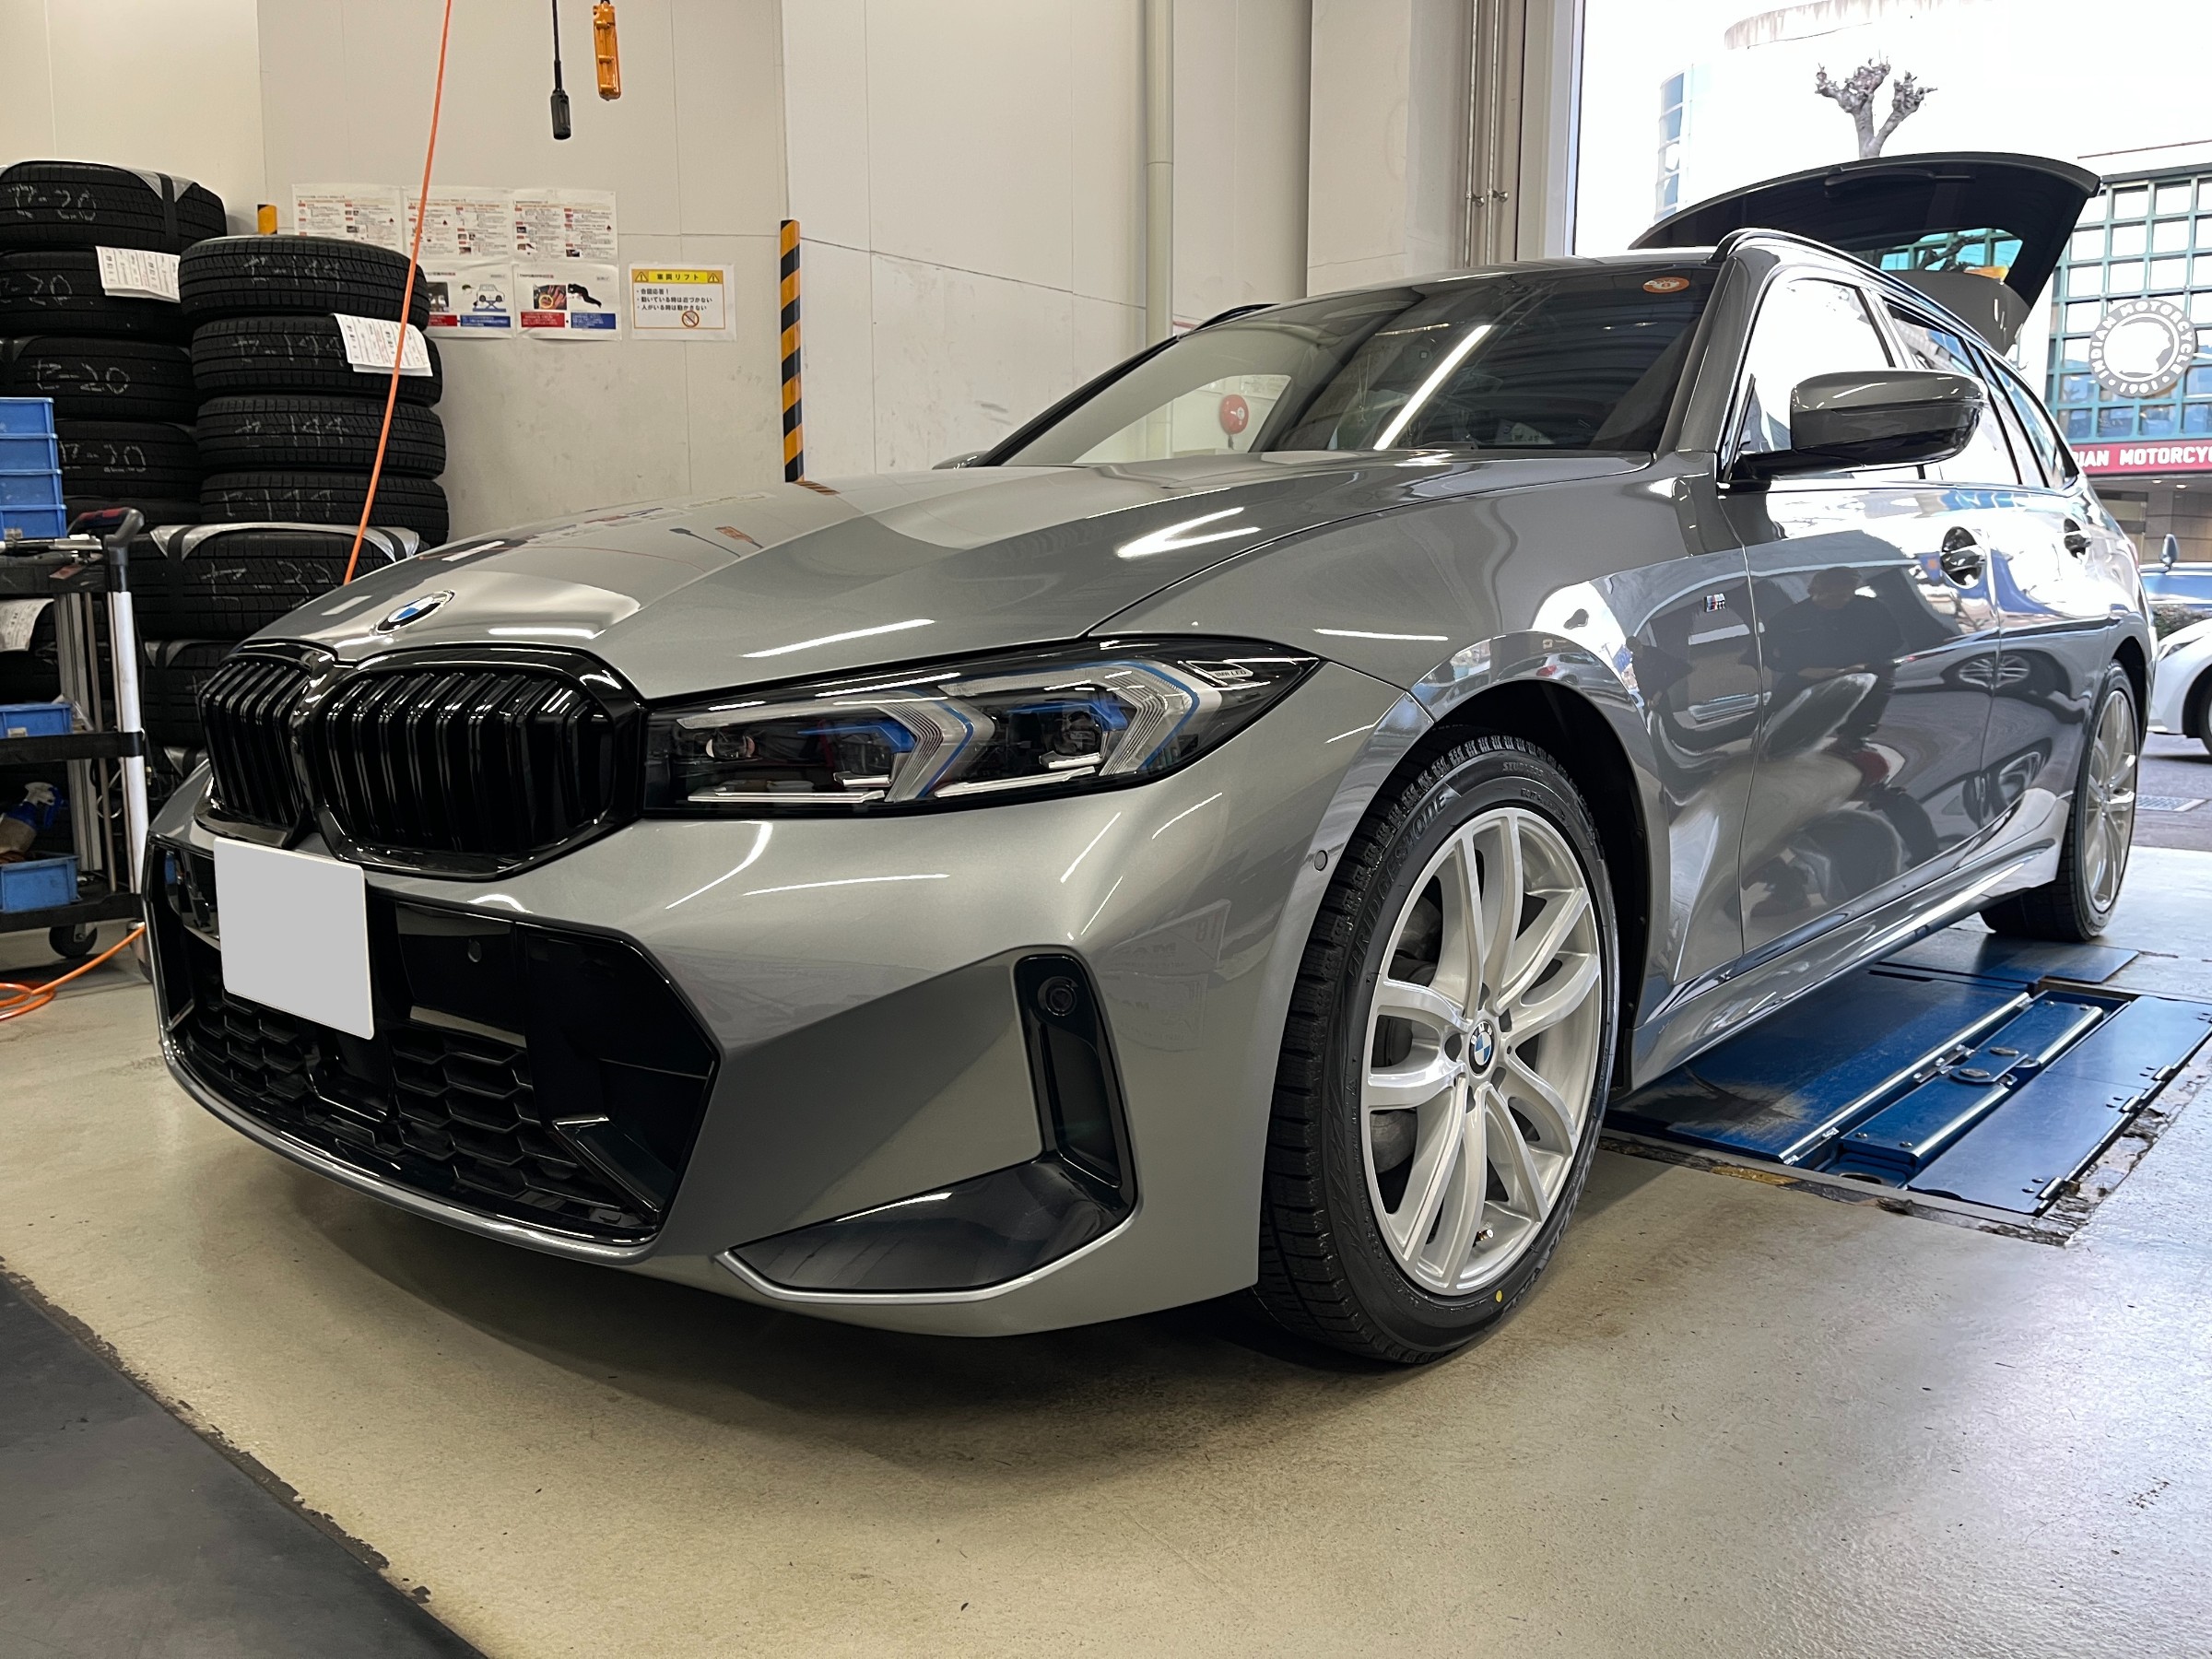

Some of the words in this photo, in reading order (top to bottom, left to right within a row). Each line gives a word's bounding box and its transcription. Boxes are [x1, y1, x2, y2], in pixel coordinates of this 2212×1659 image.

[2090, 316, 2117, 379] INDIAN
[2120, 300, 2194, 374] MOTORCYCLE
[2119, 380, 2159, 394] 1901
[2119, 446, 2212, 465] MOTORCY
[1470, 1022, 1493, 1045] BMW
